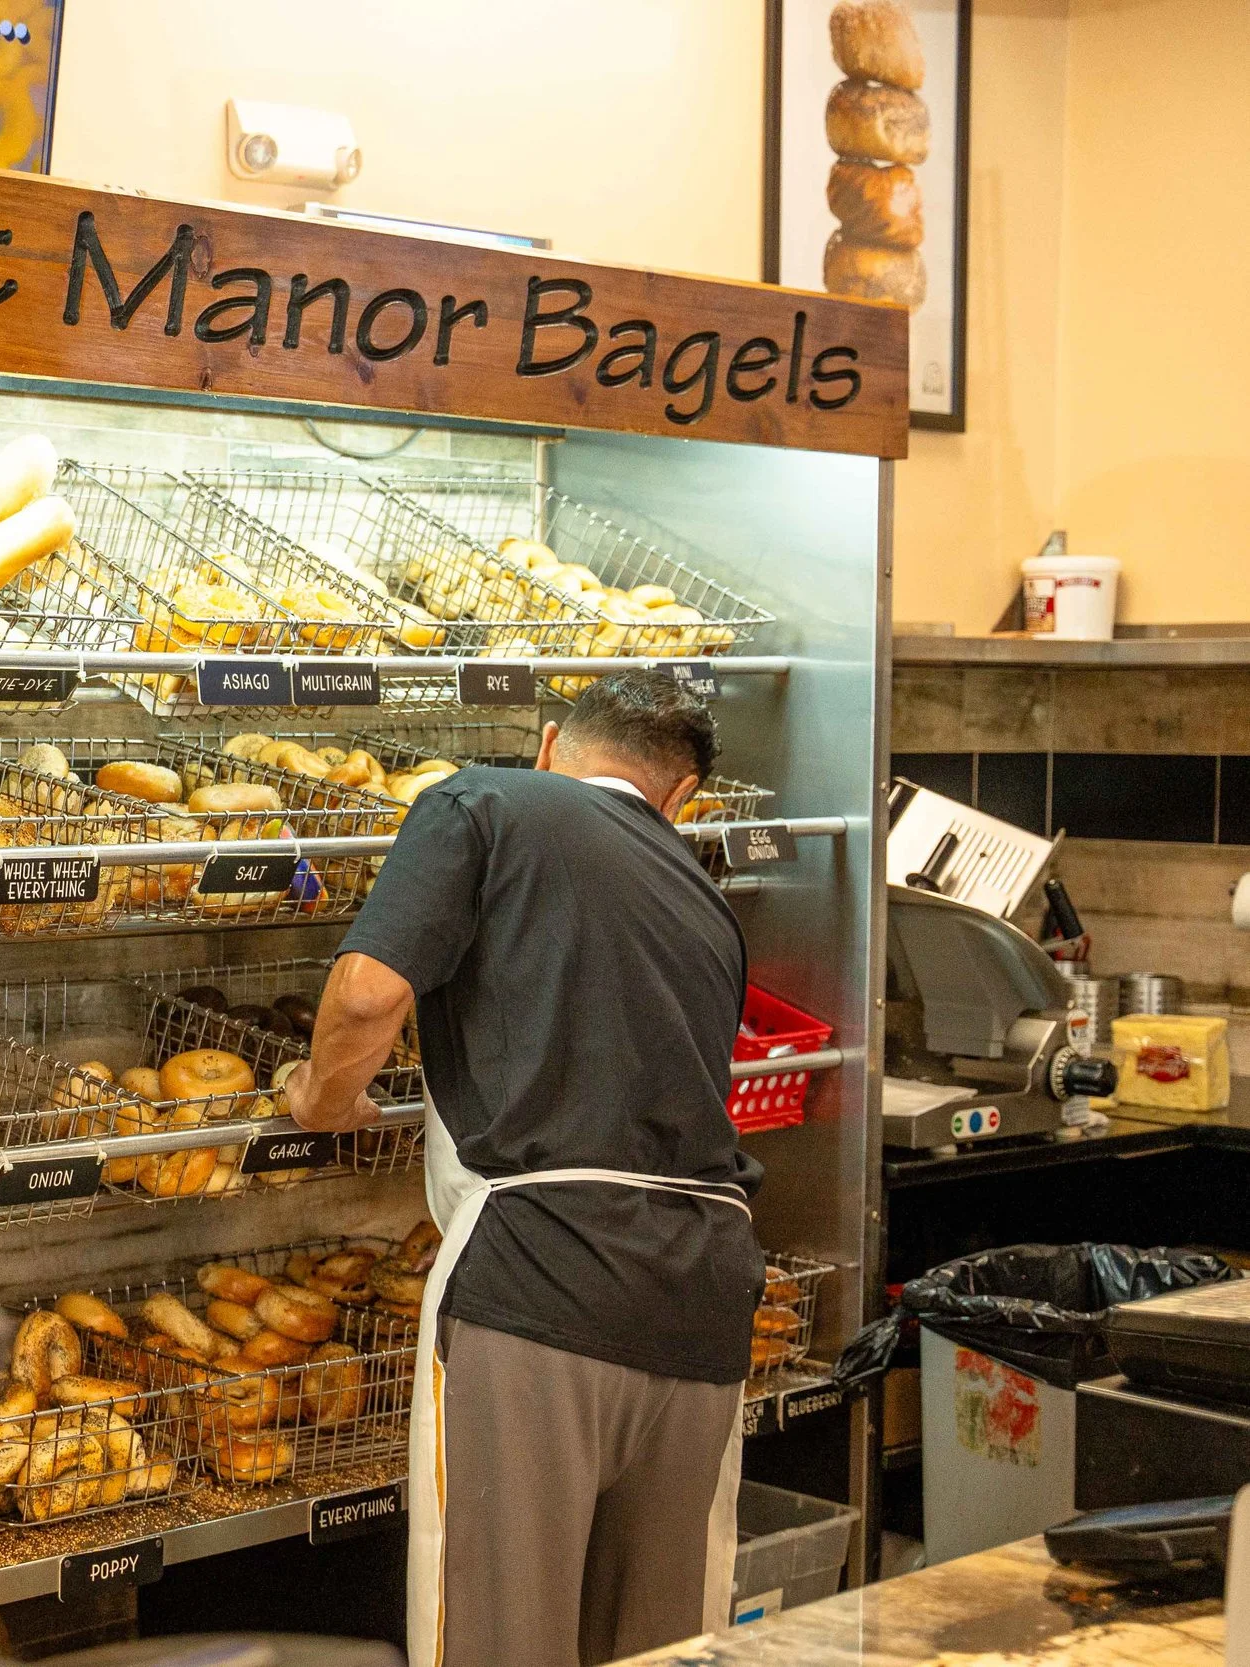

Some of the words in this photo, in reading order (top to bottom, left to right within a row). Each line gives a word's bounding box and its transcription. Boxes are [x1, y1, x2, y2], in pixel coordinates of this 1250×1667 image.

[62, 210, 488, 366] Manor
[516, 275, 863, 425] Bagels
[222, 673, 270, 690] ASIAGO
[301, 674, 373, 692] MULTIGRAIN
[486, 675, 510, 692] RYE
[749, 829, 772, 845] EGG
[747, 844, 780, 861] ONION
[3, 862, 47, 881] WHOLE
[52, 860, 94, 879] WHEAT
[235, 865, 269, 882] SALT
[7, 880, 86, 900] EVERYTHING
[268, 1140, 316, 1160] GARLIC
[28, 1168, 74, 1190] ONION
[318, 1497, 396, 1529] EVERYTHING
[90, 1554, 139, 1582] POPPY
